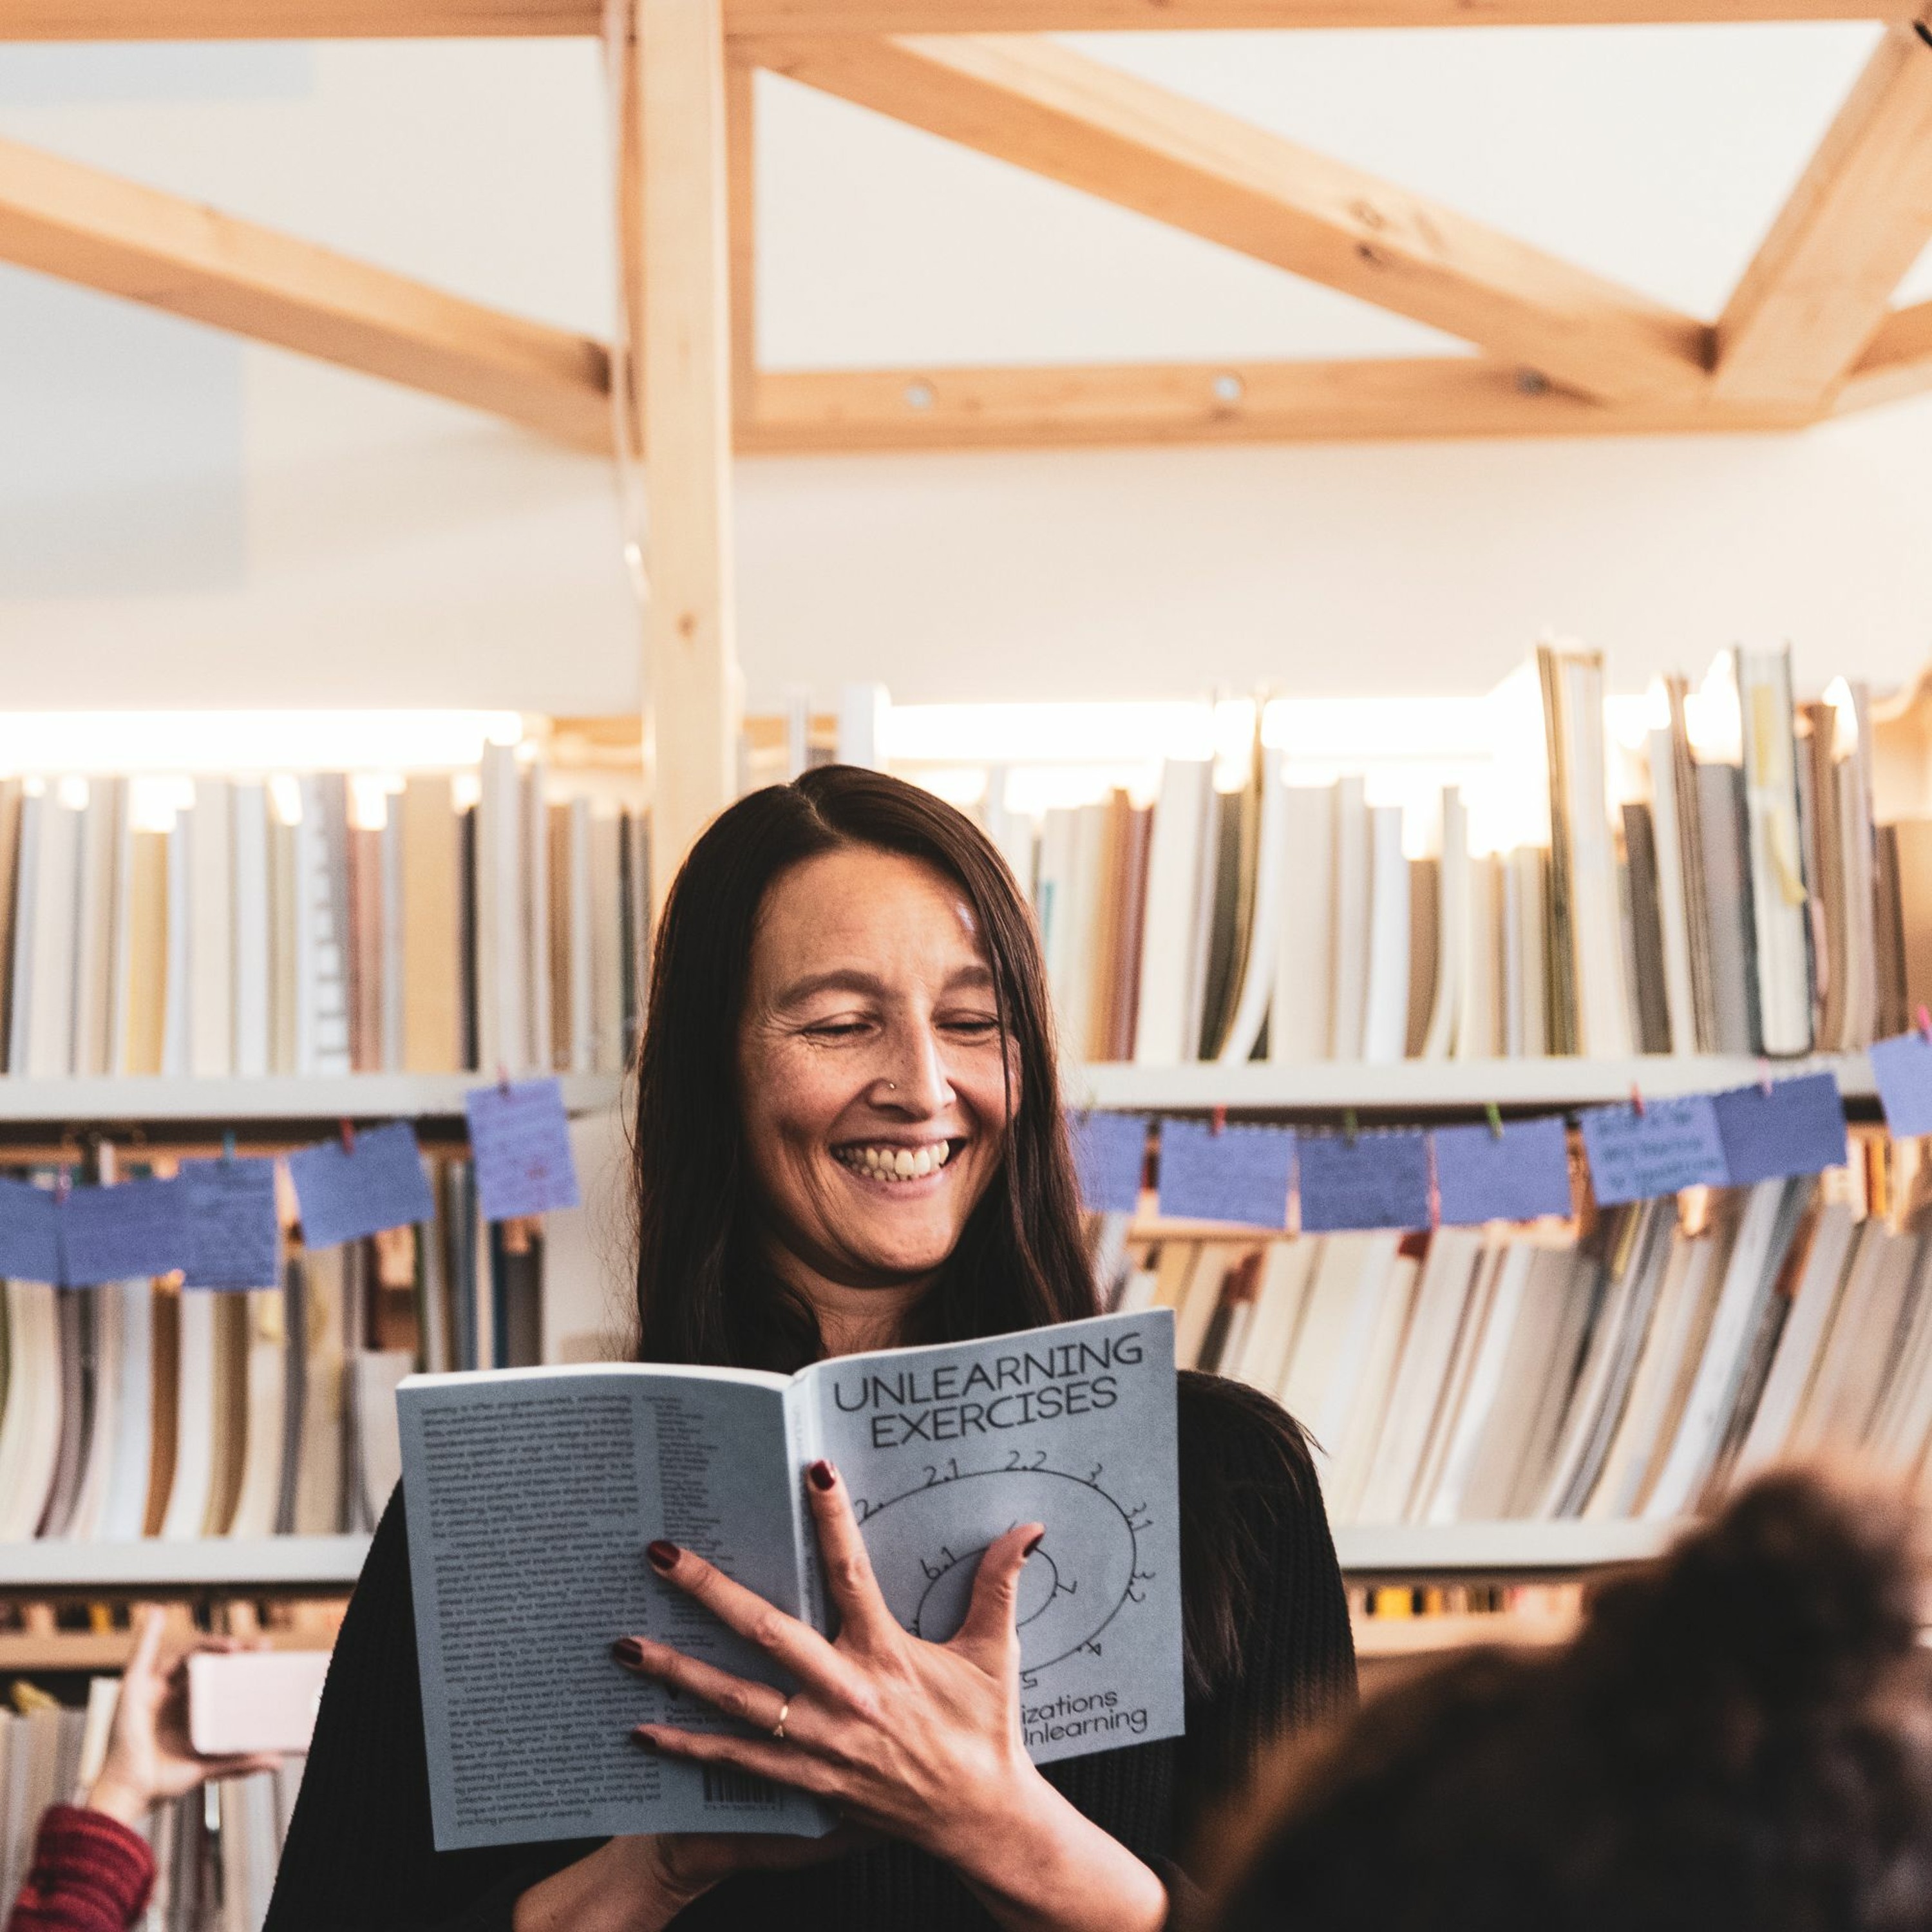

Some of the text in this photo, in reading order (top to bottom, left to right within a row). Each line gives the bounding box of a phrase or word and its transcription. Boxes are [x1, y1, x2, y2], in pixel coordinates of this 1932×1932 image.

[833, 1331, 1143, 1413] UNLEARNING
[871, 1375, 1118, 1449] EXERCISES
[1021, 1690, 1118, 1725] izations
